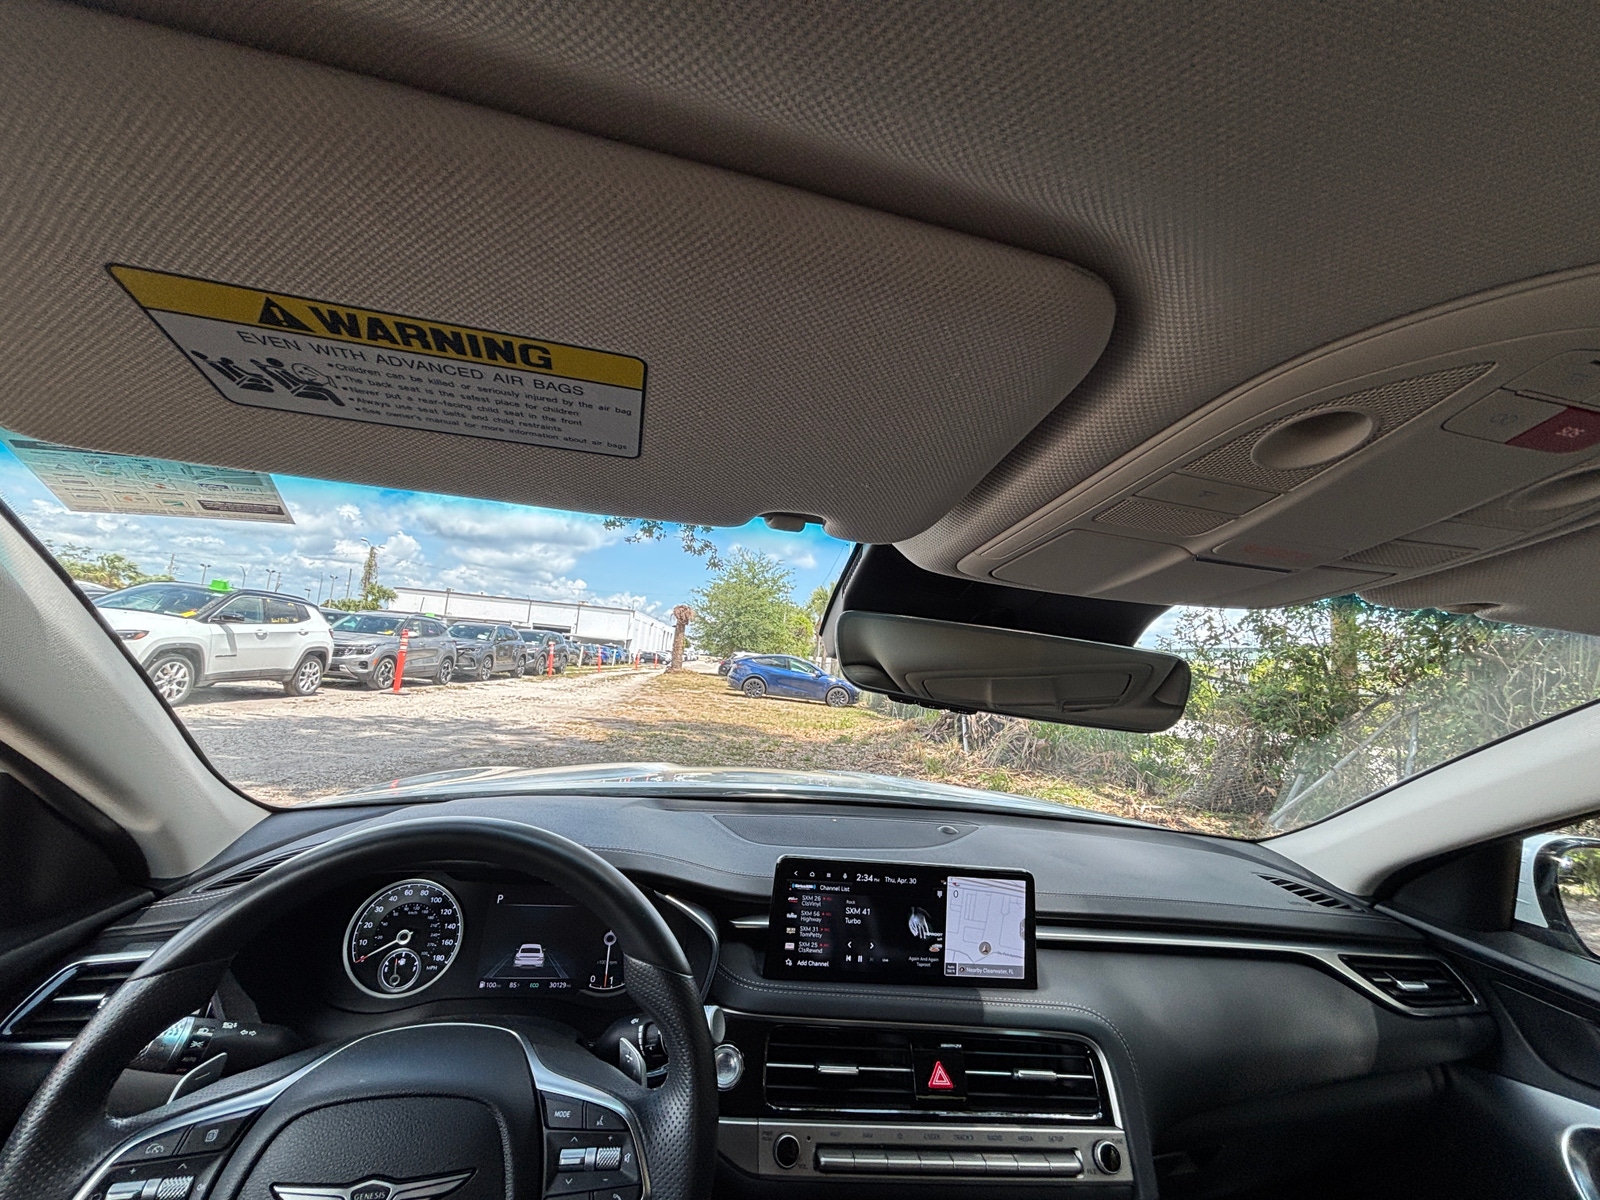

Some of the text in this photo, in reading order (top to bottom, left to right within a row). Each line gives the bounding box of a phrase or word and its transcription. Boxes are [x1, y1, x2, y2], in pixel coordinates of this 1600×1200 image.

[308, 306, 553, 370] WARNING
[237, 330, 584, 396] EVEN WITH ADVANCED AIR BAGS
[335, 363, 382, 377] Children
[385, 372, 405, 380] can
[409, 375, 423, 383] be
[428, 378, 455, 388] killed
[477, 386, 520, 398] seriously
[524, 392, 558, 403] injured
[562, 399, 574, 407] by
[578, 401, 593, 409] the
[614, 407, 632, 416] bag
[343, 375, 363, 384] The
[367, 380, 393, 388] back
[398, 384, 421, 393] seat
[438, 390, 455, 398] the
[460, 394, 490, 404] safest
[495, 399, 520, 408] place
[524, 402, 538, 410] for
[542, 406, 579, 416] children
[348, 386, 380, 396] Never
[385, 392, 402, 402] put
[477, 405, 499, 414] child
[503, 410, 524, 418] seat
[561, 417, 583, 426] front
[356, 397, 391, 408] Always
[395, 403, 413, 411] use
[417, 406, 439, 415] seat
[442, 409, 466, 418] belts
[492, 417, 514, 425] child
[518, 421, 562, 432] restraints
[425, 417, 460, 426] manual
[508, 428, 559, 440] information
[563, 436, 587, 444] about
[607, 442, 627, 450] bags
[856, 873, 873, 882] 2:34
[908, 877, 917, 885] 30
[819, 884, 840, 892] Channel
[496, 894, 504, 904] P
[374, 905, 384, 913] 30
[845, 907, 871, 915] SXM 41
[845, 917, 862, 925] Turbo
[444, 922, 456, 930] 140
[590, 975, 596, 983] 0
[609, 976, 614, 984] 1
[554, 1110, 571, 1118] MODE
[353, 1191, 386, 1200] GENESIS
